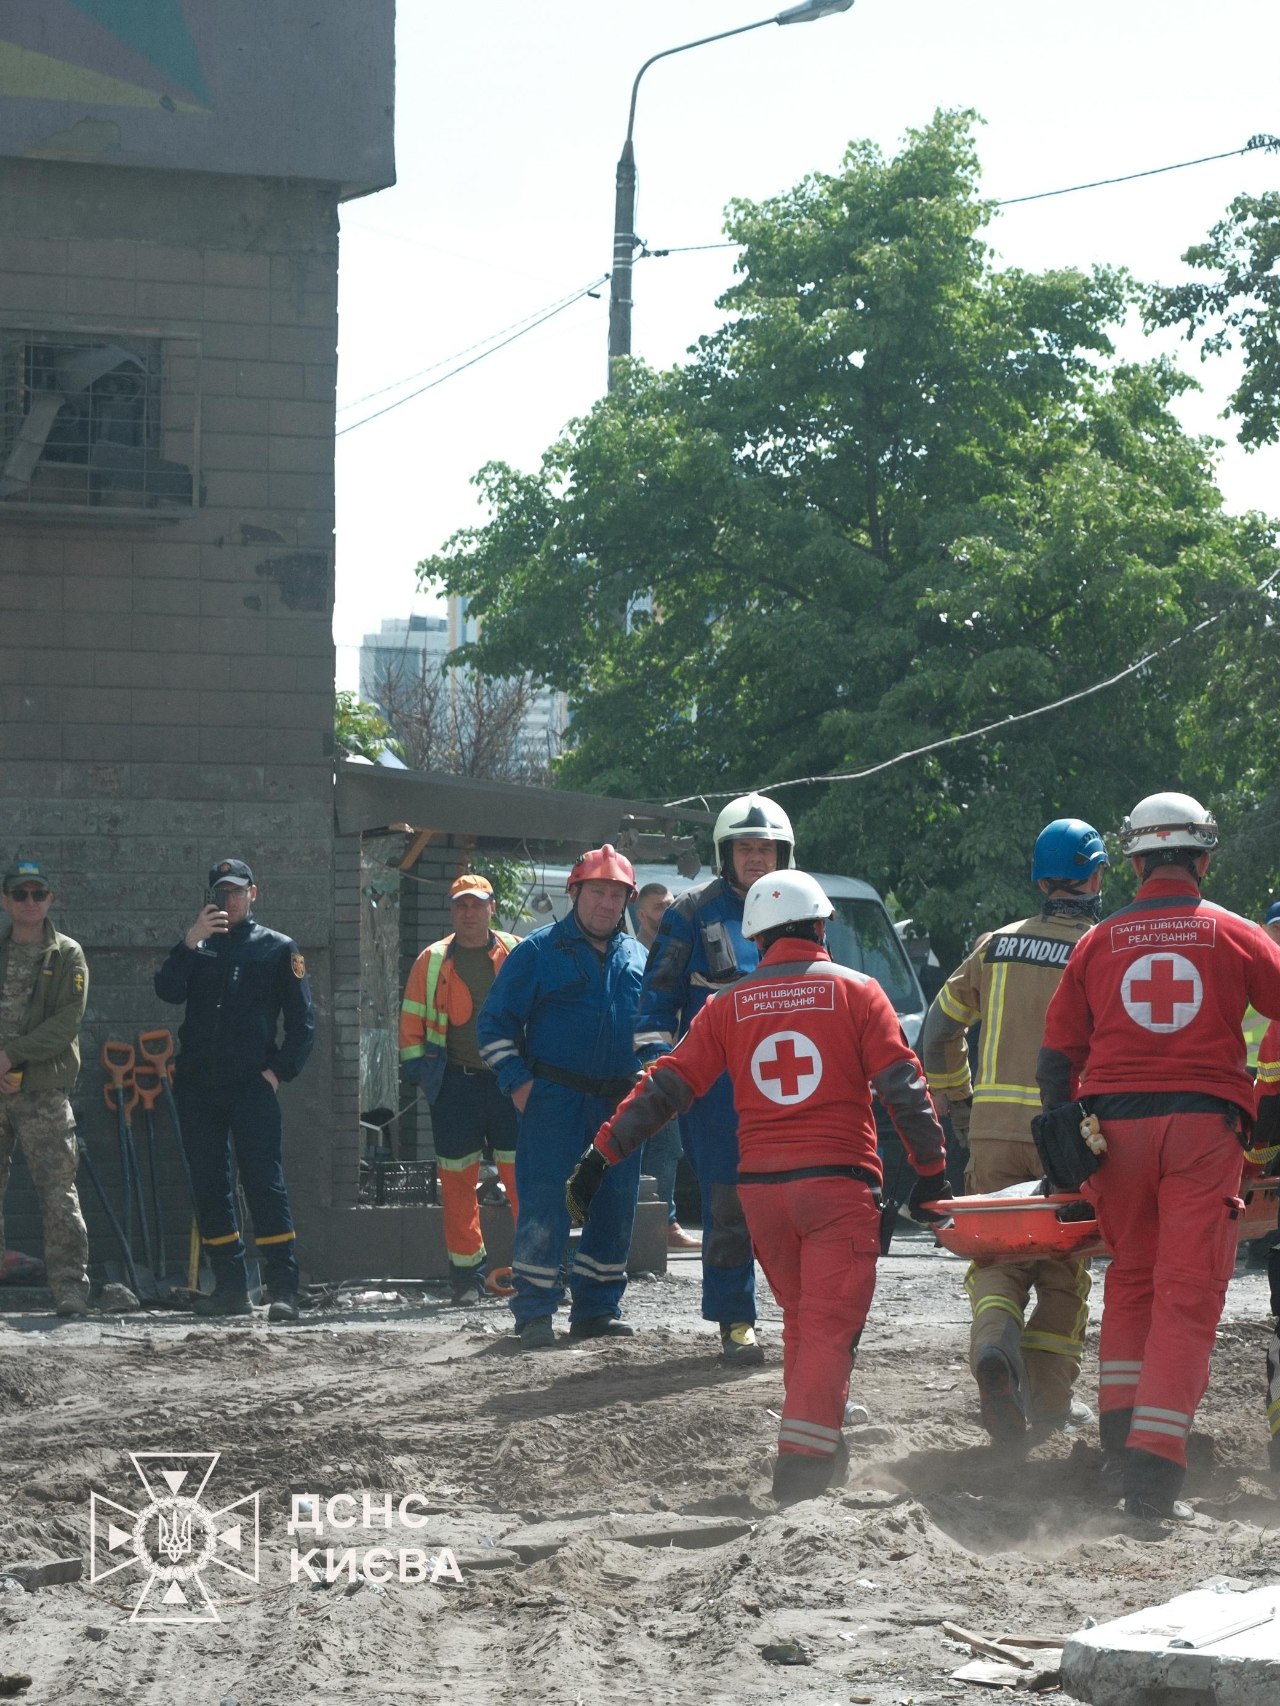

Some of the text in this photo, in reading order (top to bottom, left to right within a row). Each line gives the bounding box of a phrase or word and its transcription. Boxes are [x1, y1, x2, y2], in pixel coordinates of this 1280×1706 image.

[1116, 920, 1210, 935] ЗАГІН ШВИДКОГО
[1128, 932, 1198, 944] РЕАГУВАННЯ
[742, 987, 825, 1003] ЗАГІН ШВИДКОГО
[753, 997, 814, 1010] РЕАГУВАННЯ
